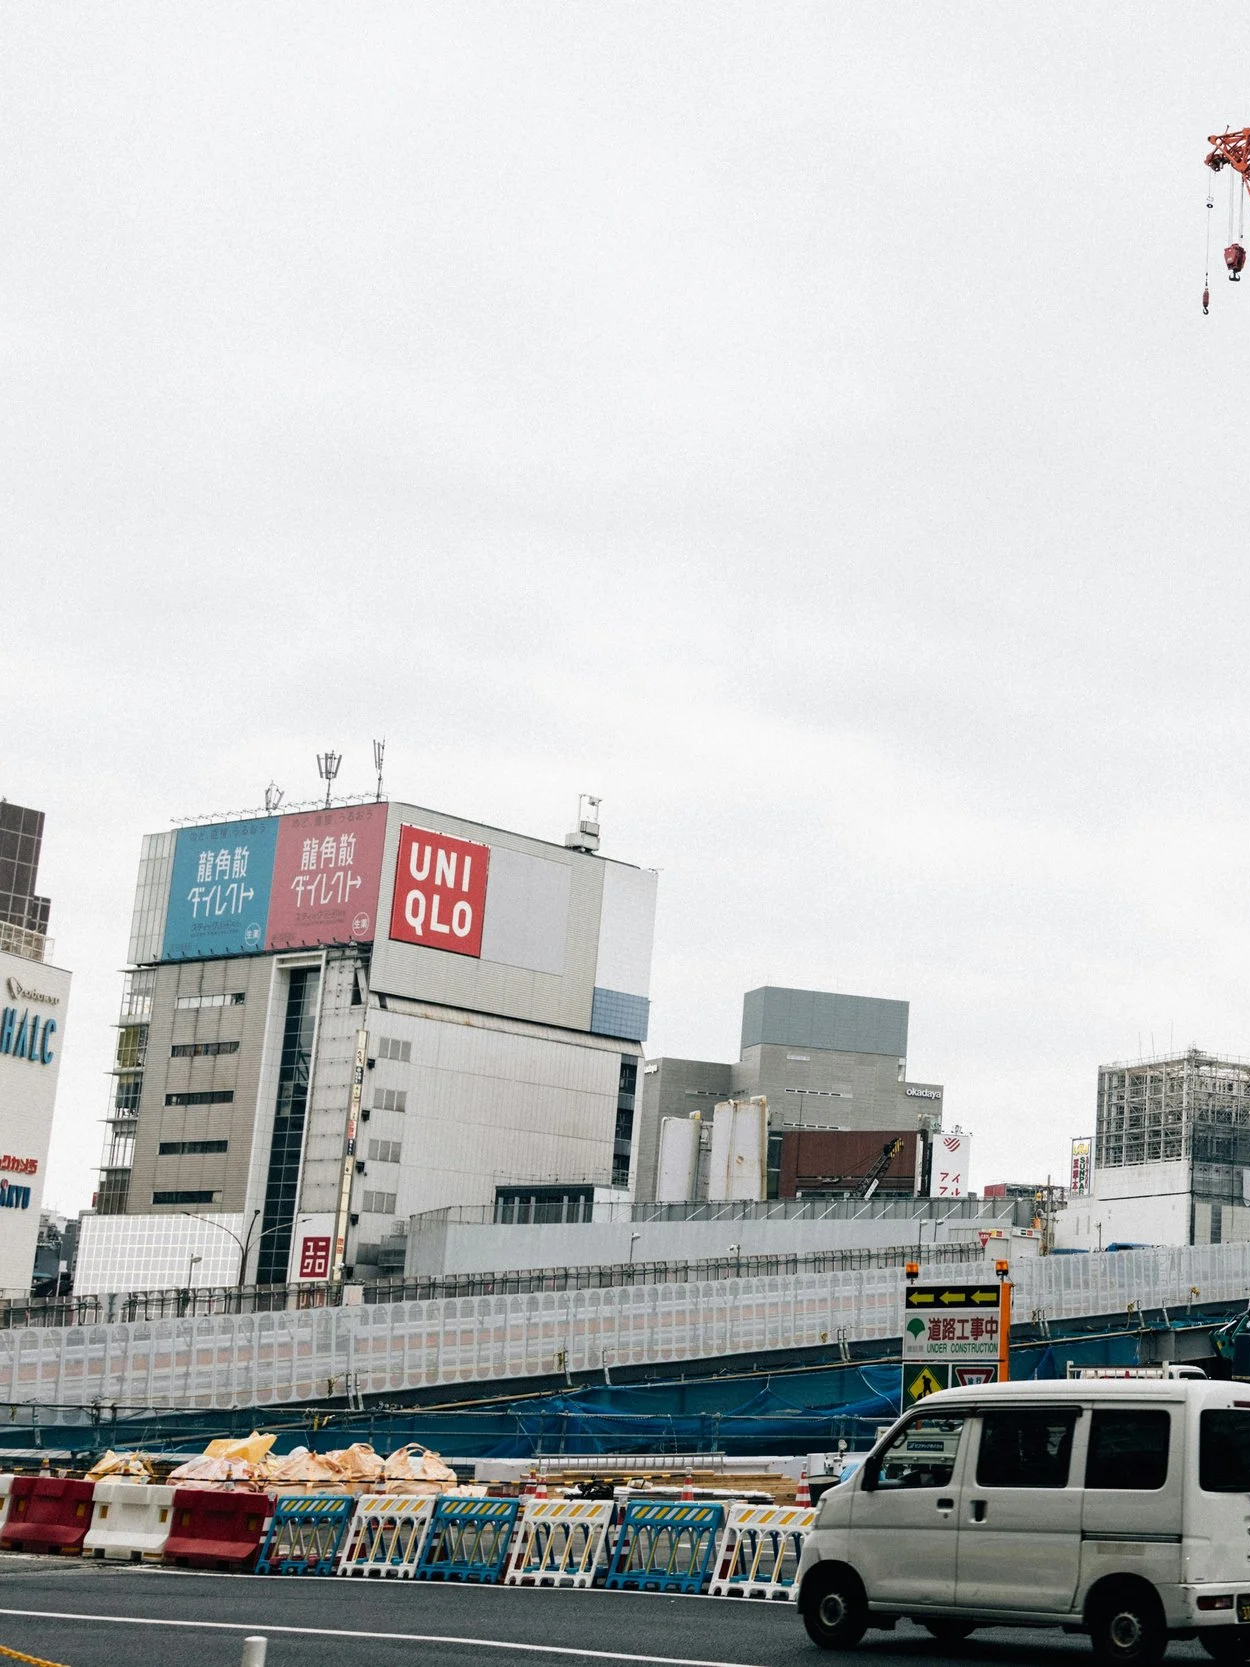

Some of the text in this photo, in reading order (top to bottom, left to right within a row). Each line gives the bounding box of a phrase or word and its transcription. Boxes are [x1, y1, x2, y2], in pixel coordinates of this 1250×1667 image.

[197, 846, 250, 883] 龍角散
[301, 832, 357, 871] 龍角散
[409, 841, 472, 893] UNI
[187, 882, 255, 919] ダイレクト
[290, 870, 362, 908] ダイレクト
[404, 889, 473, 938] QLO
[0, 1006, 57, 1065] HALC
[906, 1088, 941, 1099] okadaya
[302, 1258, 325, 1273] クロ
[305, 1241, 327, 1256] ユニ
[927, 1316, 999, 1341] 道路工事中
[926, 1342, 948, 1354] UNDER
[950, 1342, 998, 1354] CONSTRUCTION
